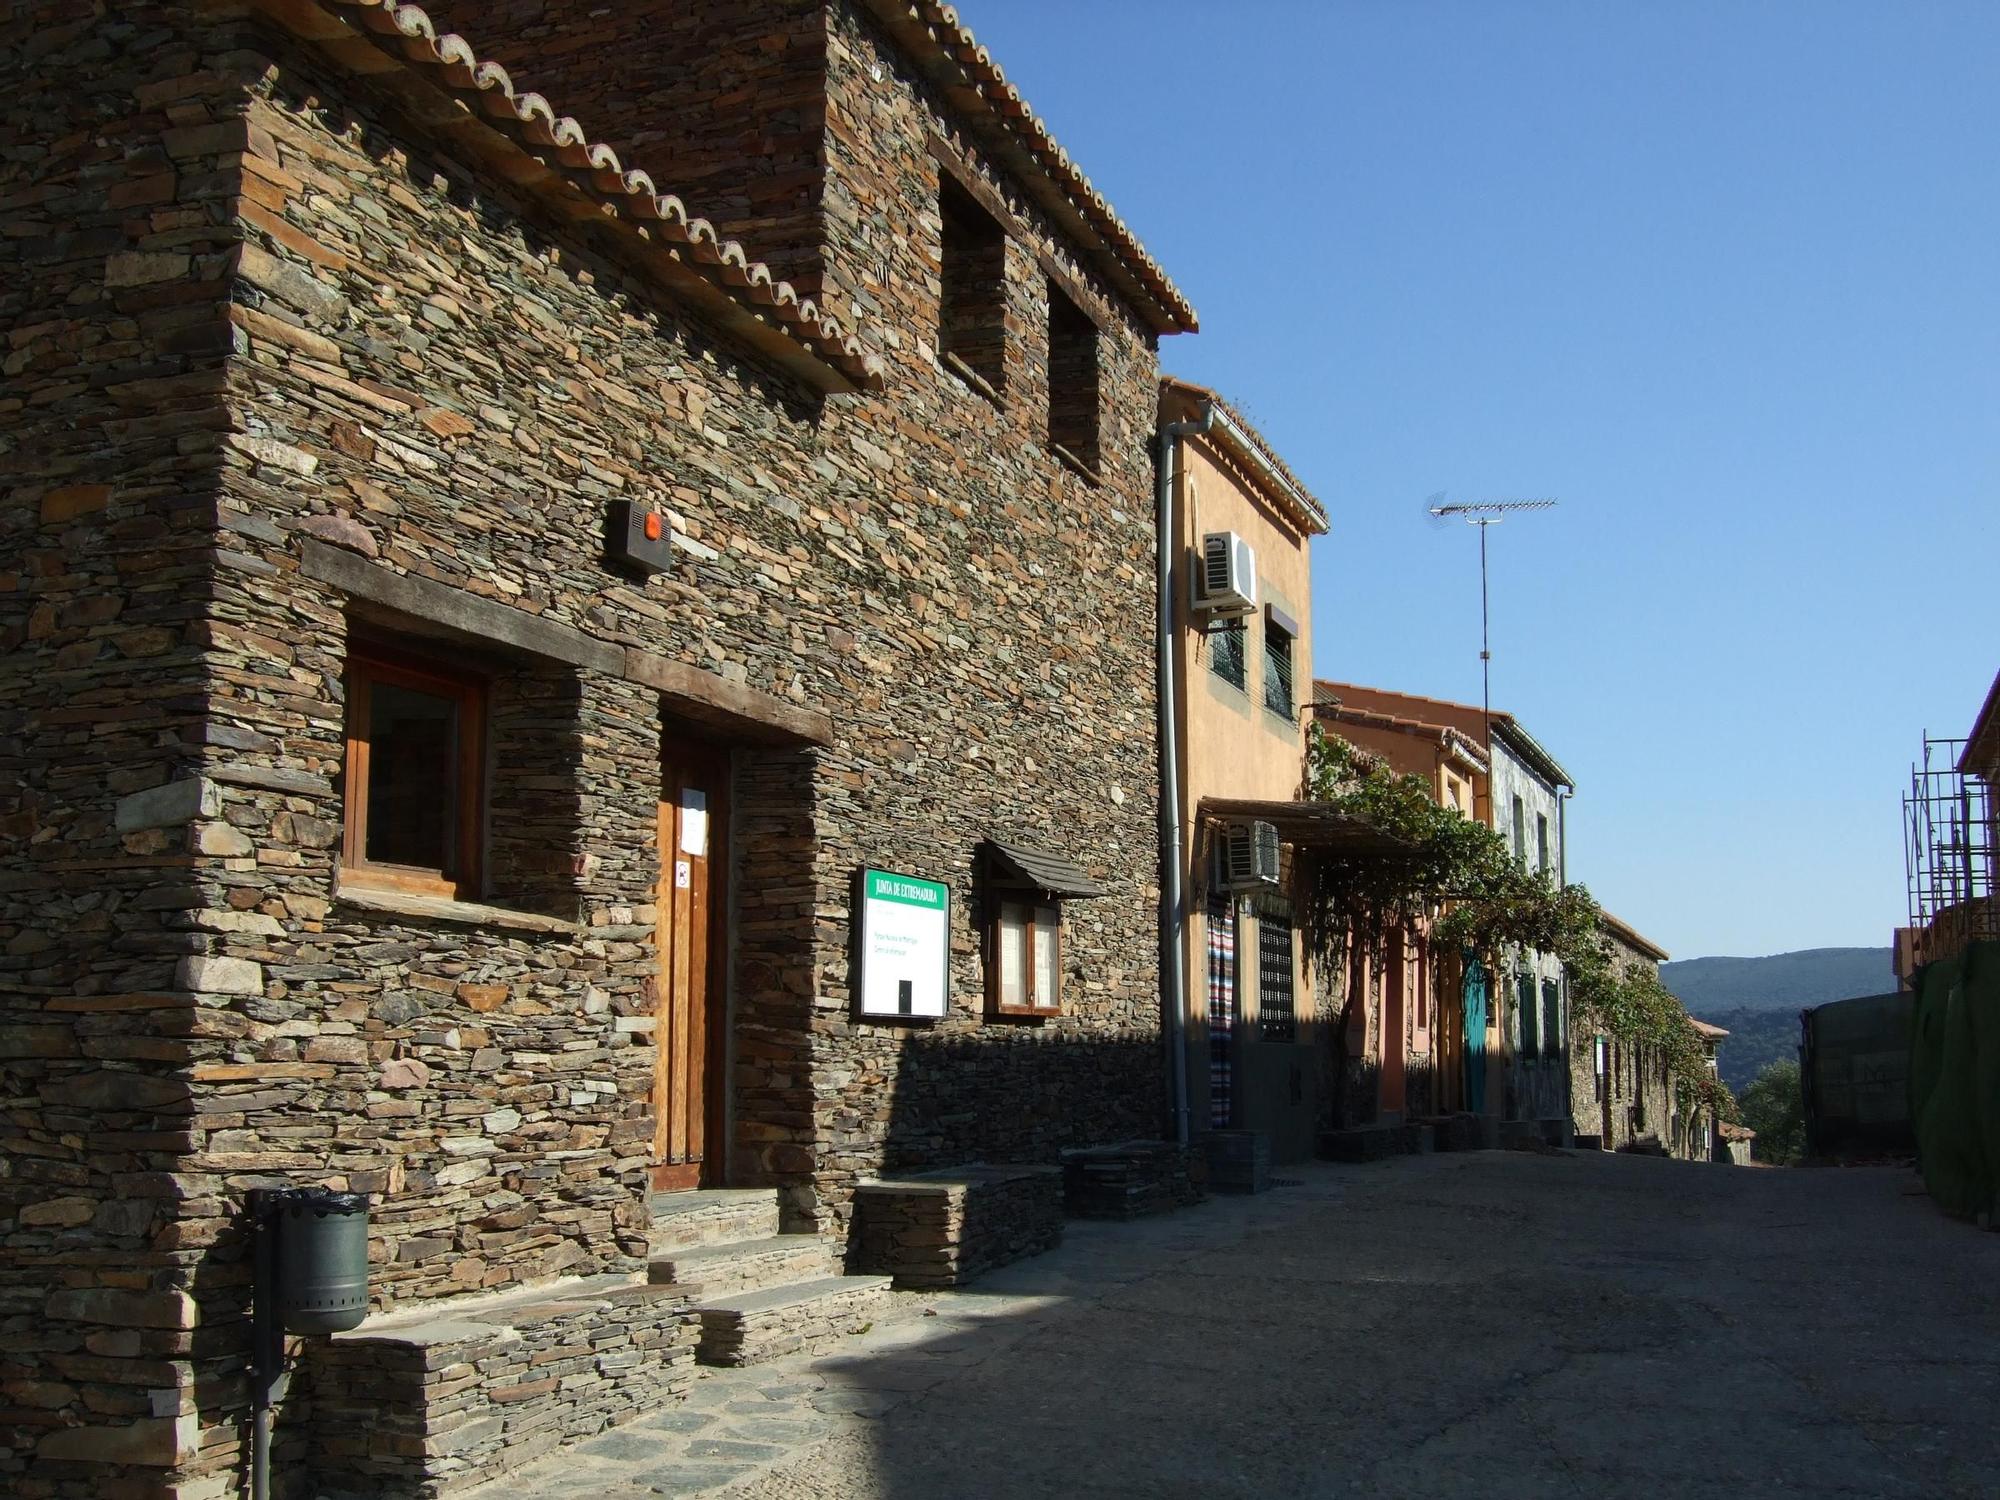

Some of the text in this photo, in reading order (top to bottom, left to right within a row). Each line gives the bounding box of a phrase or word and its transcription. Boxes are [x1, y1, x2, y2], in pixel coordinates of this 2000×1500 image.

[875, 878, 938, 904] JUNTA DE EXTREMADURA
